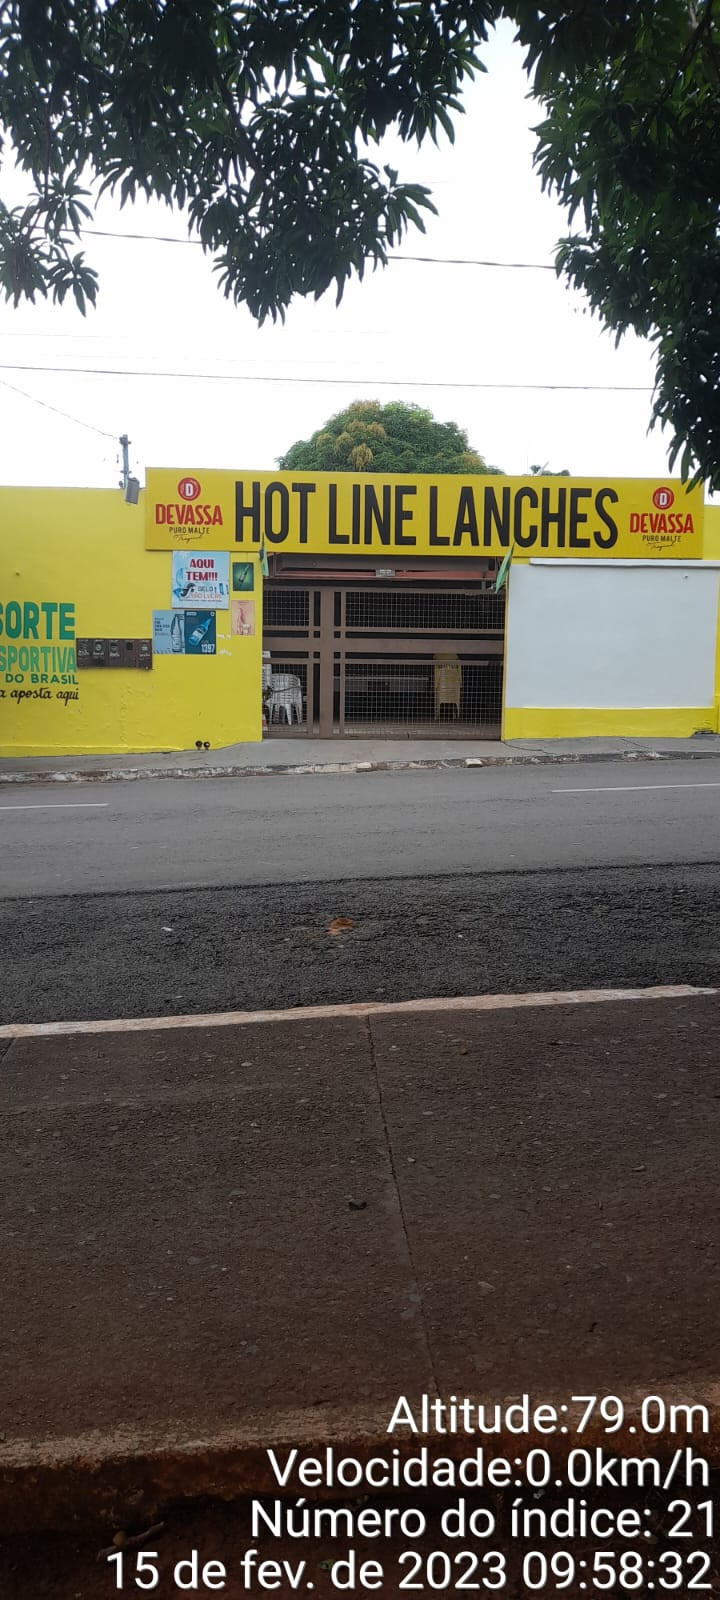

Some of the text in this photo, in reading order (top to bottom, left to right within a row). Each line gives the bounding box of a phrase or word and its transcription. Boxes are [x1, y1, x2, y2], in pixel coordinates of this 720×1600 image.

[185, 483, 194, 497] D
[659, 492, 668, 506] D
[155, 503, 223, 526] DEVASSA
[235, 481, 619, 549] HOT LINE LANCHES
[629, 512, 694, 534] DEVASSA
[168, 526, 210, 535] PURO MALTE
[642, 534, 682, 543] PURO MALTE
[189, 558, 215, 569] AQUI
[185, 571, 218, 582] TEM!!!
[0, 600, 76, 640] ORTE
[5, 673, 79, 685] DO BRASIL
[10, 686, 53, 704] aposta
[56, 687, 79, 707] aqui
